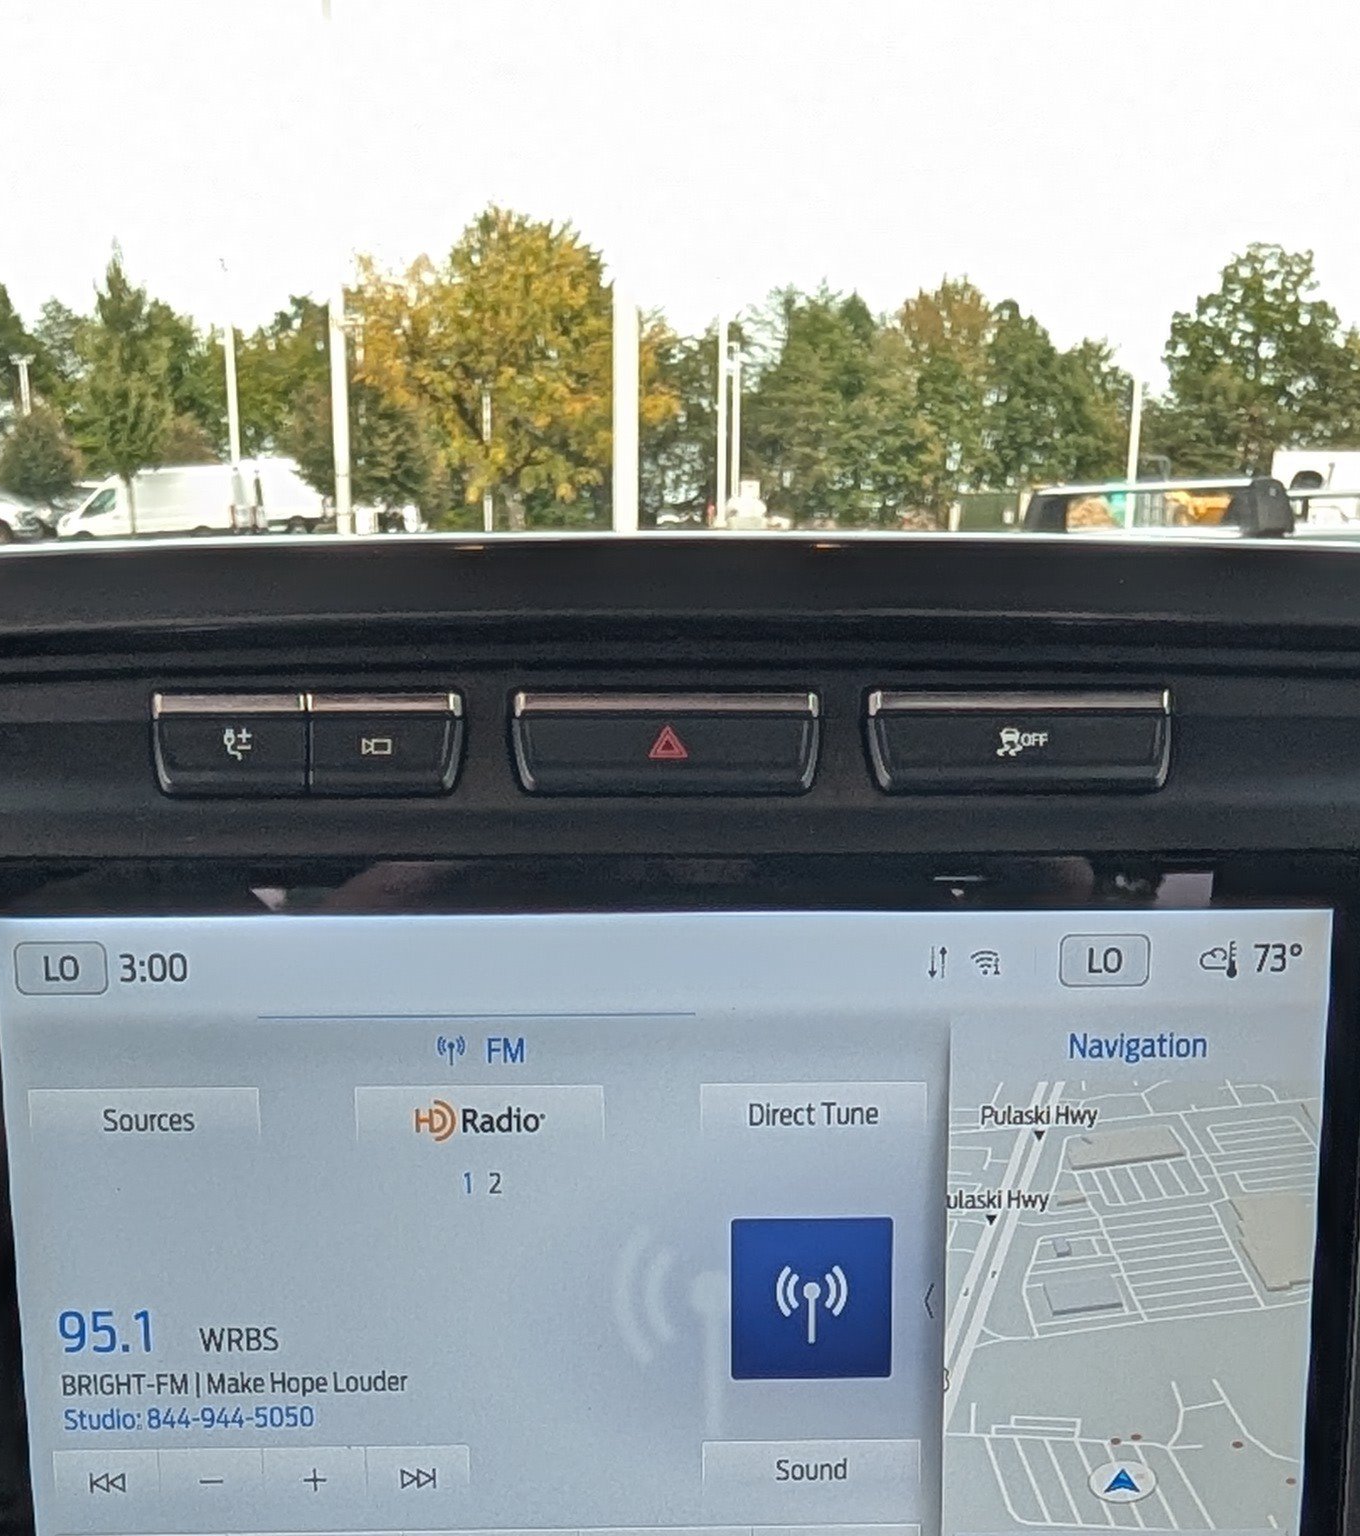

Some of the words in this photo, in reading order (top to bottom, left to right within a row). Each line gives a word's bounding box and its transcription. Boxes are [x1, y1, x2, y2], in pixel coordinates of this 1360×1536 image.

[1020, 732, 1048, 746] OFF
[43, 955, 80, 983] LO
[119, 952, 188, 983] 3:00
[1087, 946, 1123, 974] LO
[1253, 943, 1303, 974] 73°
[487, 1037, 525, 1064] FM
[1068, 1032, 1208, 1060] Navigation
[102, 1108, 196, 1134] Sources
[748, 1102, 816, 1126] Direct
[821, 1102, 880, 1126] Tune
[981, 1105, 1051, 1126] Pulaski
[1054, 1105, 1098, 1128] Hwy
[464, 1172, 472, 1194] 1
[489, 1172, 502, 1194] 2
[946, 1189, 1003, 1210] ulaski
[1006, 1189, 1050, 1213] Hwy
[58, 1310, 152, 1353] 95.1
[199, 1327, 280, 1352] WRBS
[61, 1374, 189, 1397] BRIGHT-FM
[206, 1372, 265, 1394] Make
[270, 1372, 329, 1397] Hope
[332, 1370, 408, 1393] Louder
[63, 1408, 143, 1431] Studio:
[147, 1405, 315, 1429] 844-944-5050
[775, 1459, 847, 1482] Sound
